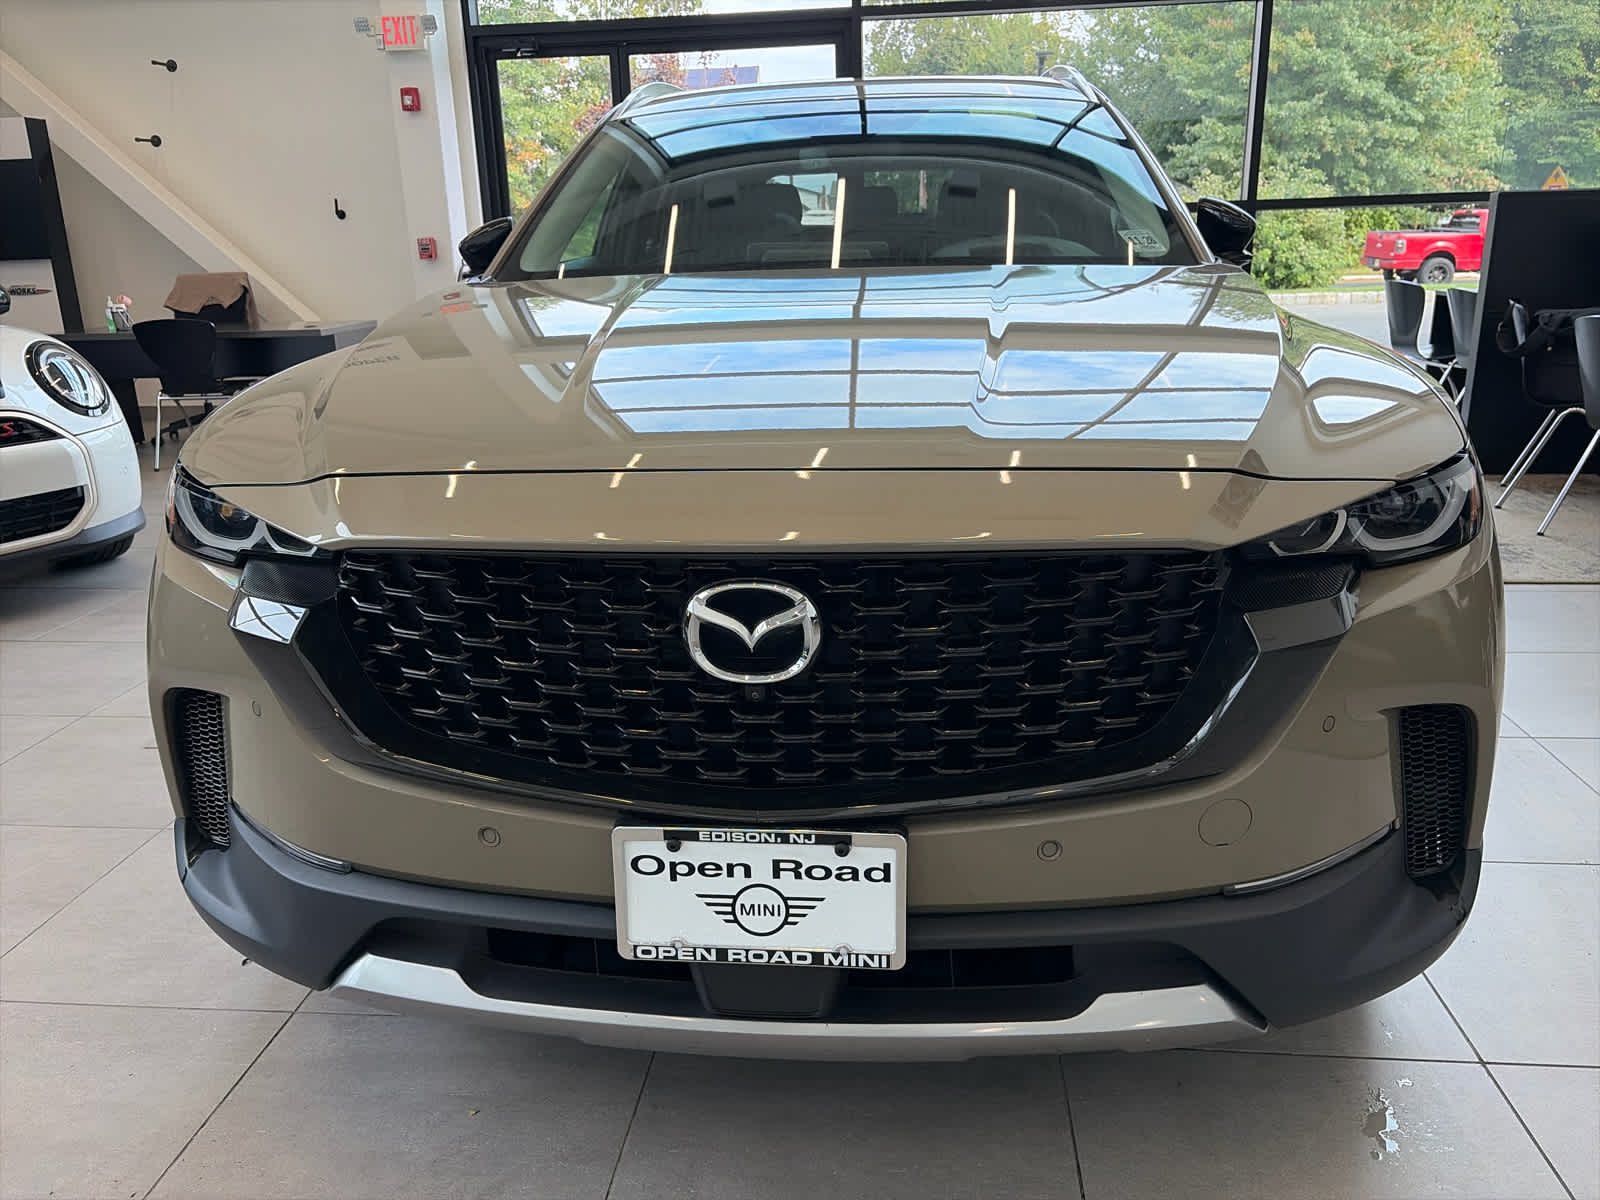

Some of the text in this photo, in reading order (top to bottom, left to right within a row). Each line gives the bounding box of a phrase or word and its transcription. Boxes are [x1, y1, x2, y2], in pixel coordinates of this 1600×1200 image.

[381, 16, 416, 45] EXIT
[10, 288, 36, 296] WORKS
[698, 831, 816, 844] EDISON, NJ
[630, 854, 891, 883] Open Road
[740, 903, 781, 917] MINI
[636, 946, 888, 968] OPEN ROAD MINI
